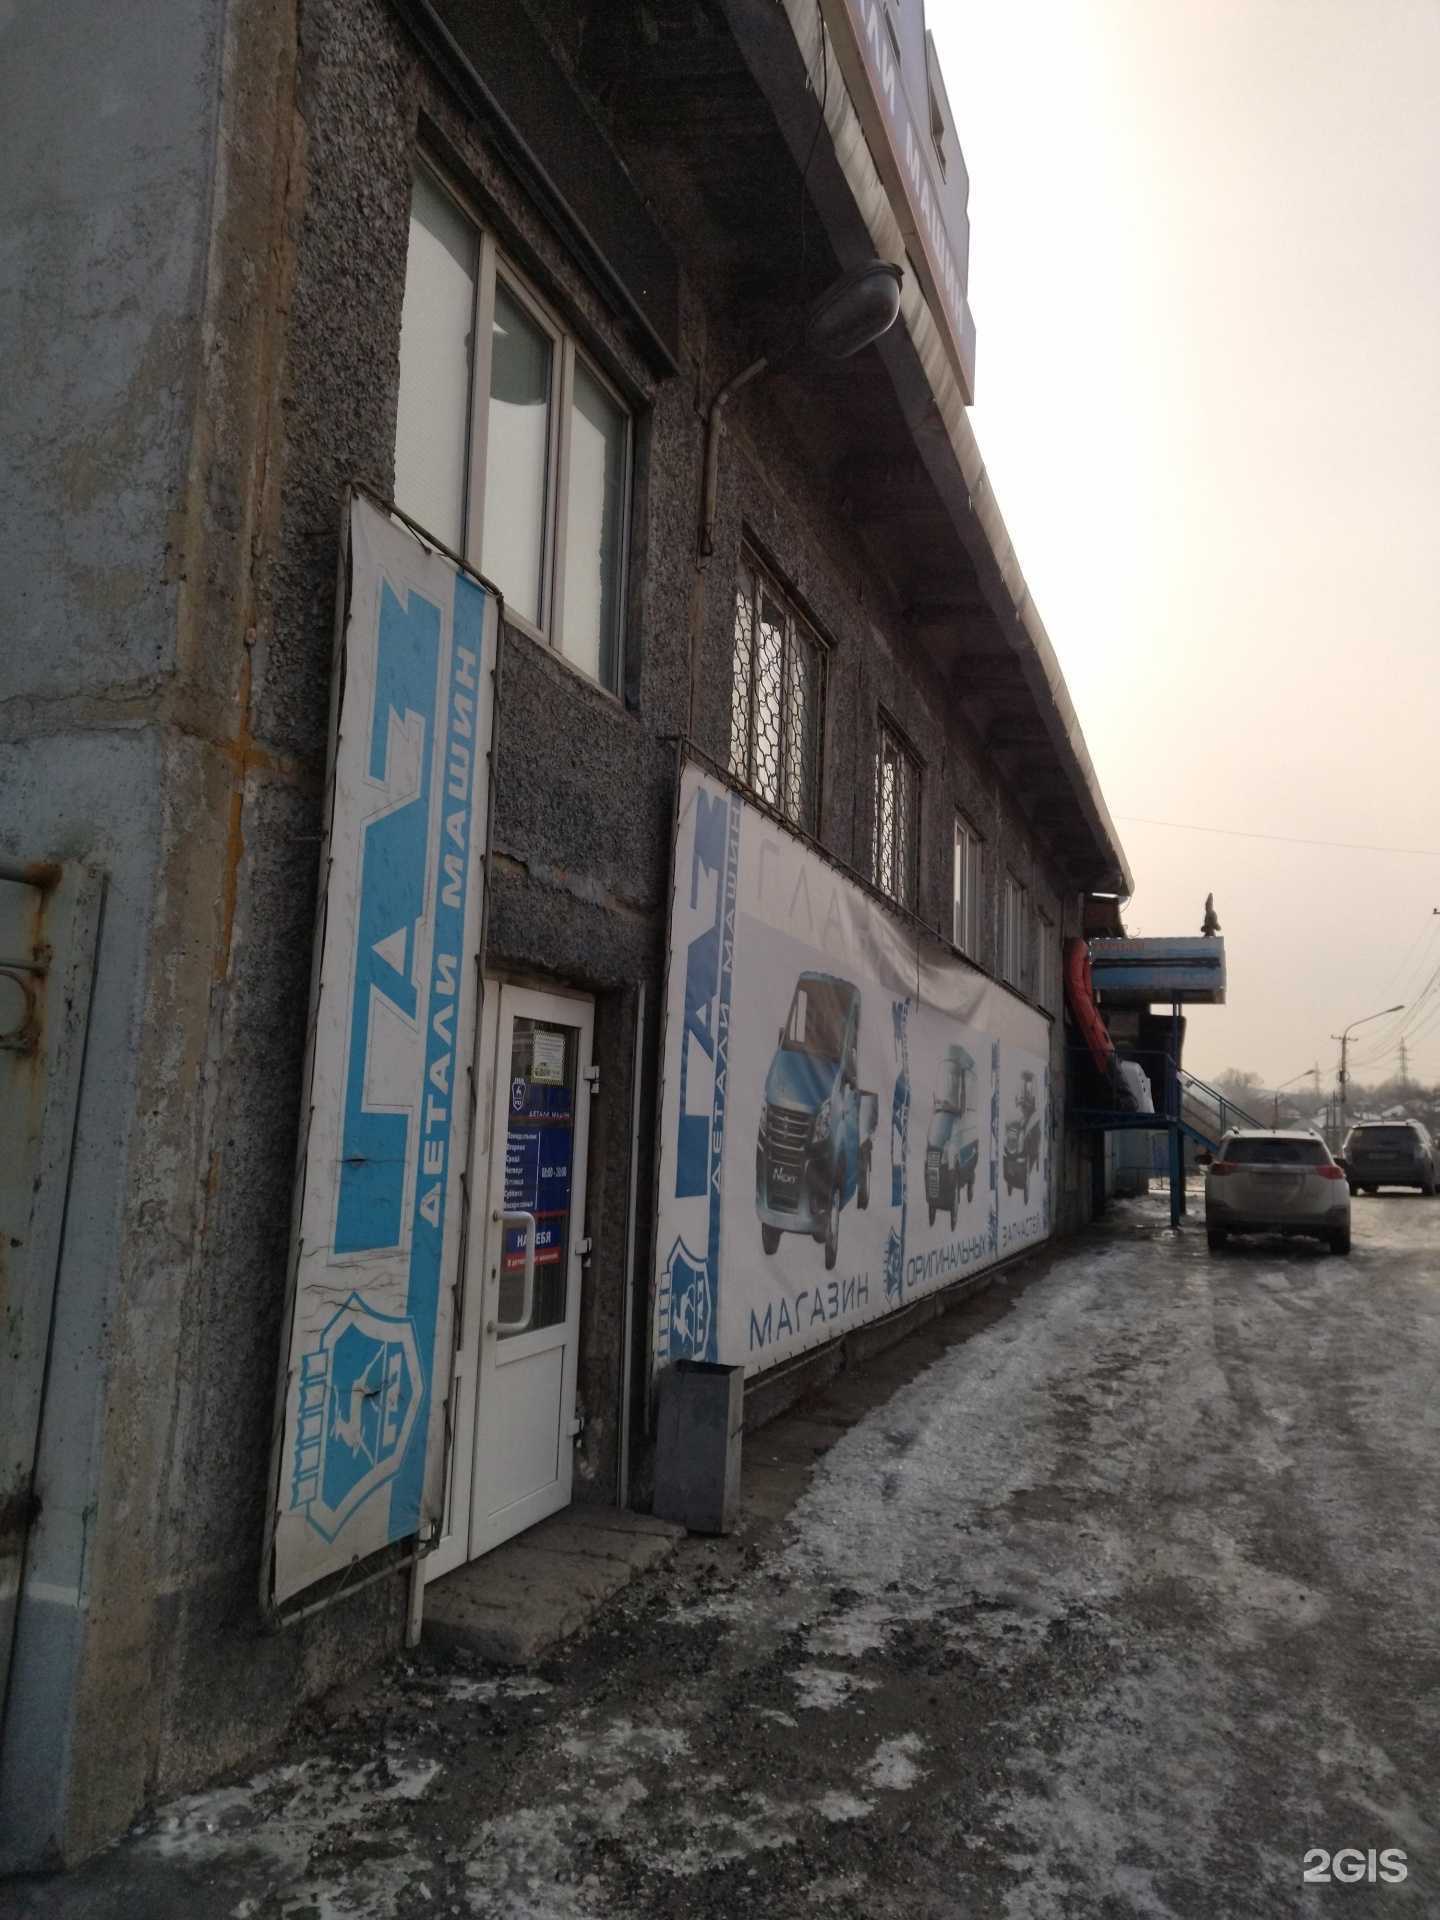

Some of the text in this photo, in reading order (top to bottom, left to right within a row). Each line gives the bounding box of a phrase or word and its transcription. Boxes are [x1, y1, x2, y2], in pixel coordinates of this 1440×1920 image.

[418, 646, 477, 1228] ДЕТАЛИ МАШИН
[711, 807, 742, 1194] ДЕТАЛИ МАШИН
[748, 1271, 870, 1352] МАГАЗИН
